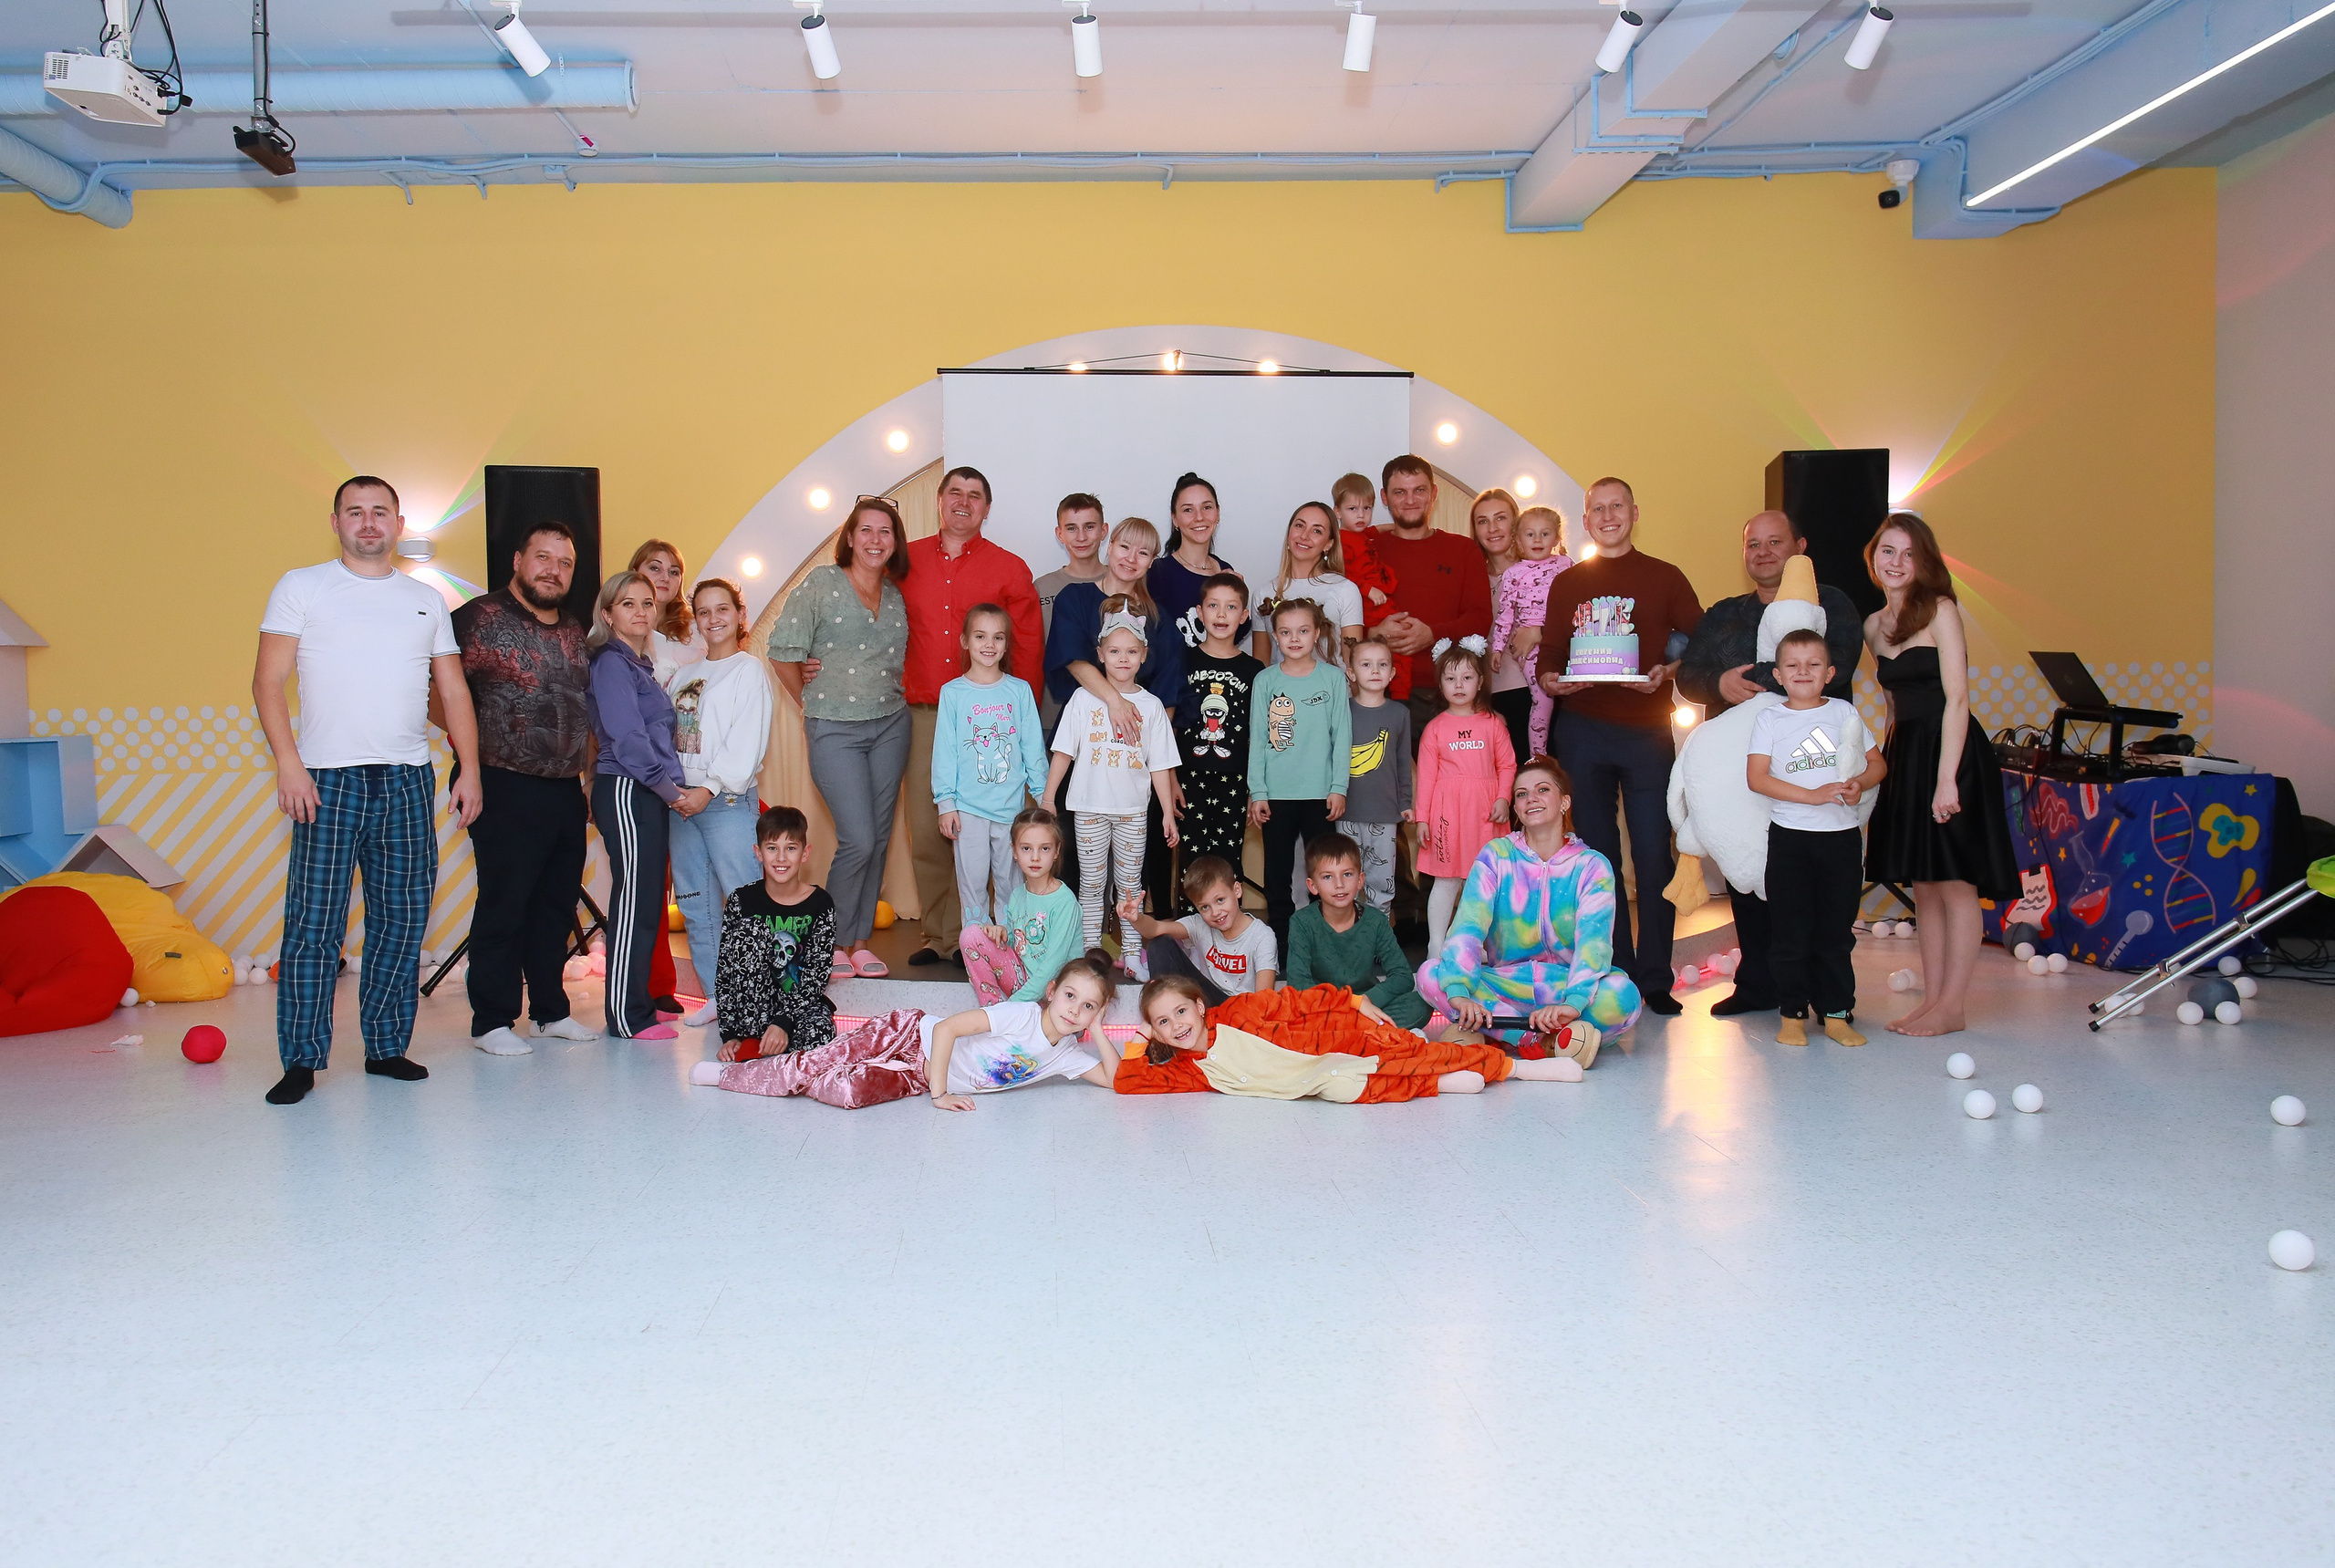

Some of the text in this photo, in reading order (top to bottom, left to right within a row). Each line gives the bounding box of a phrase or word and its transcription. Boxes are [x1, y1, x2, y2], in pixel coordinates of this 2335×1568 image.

[972, 703, 1004, 716] Bonjour
[1458, 730, 1472, 739] MY
[1448, 740, 1485, 752] WORLD
[1785, 753, 1837, 774] adida
[753, 914, 812, 935] AMER
